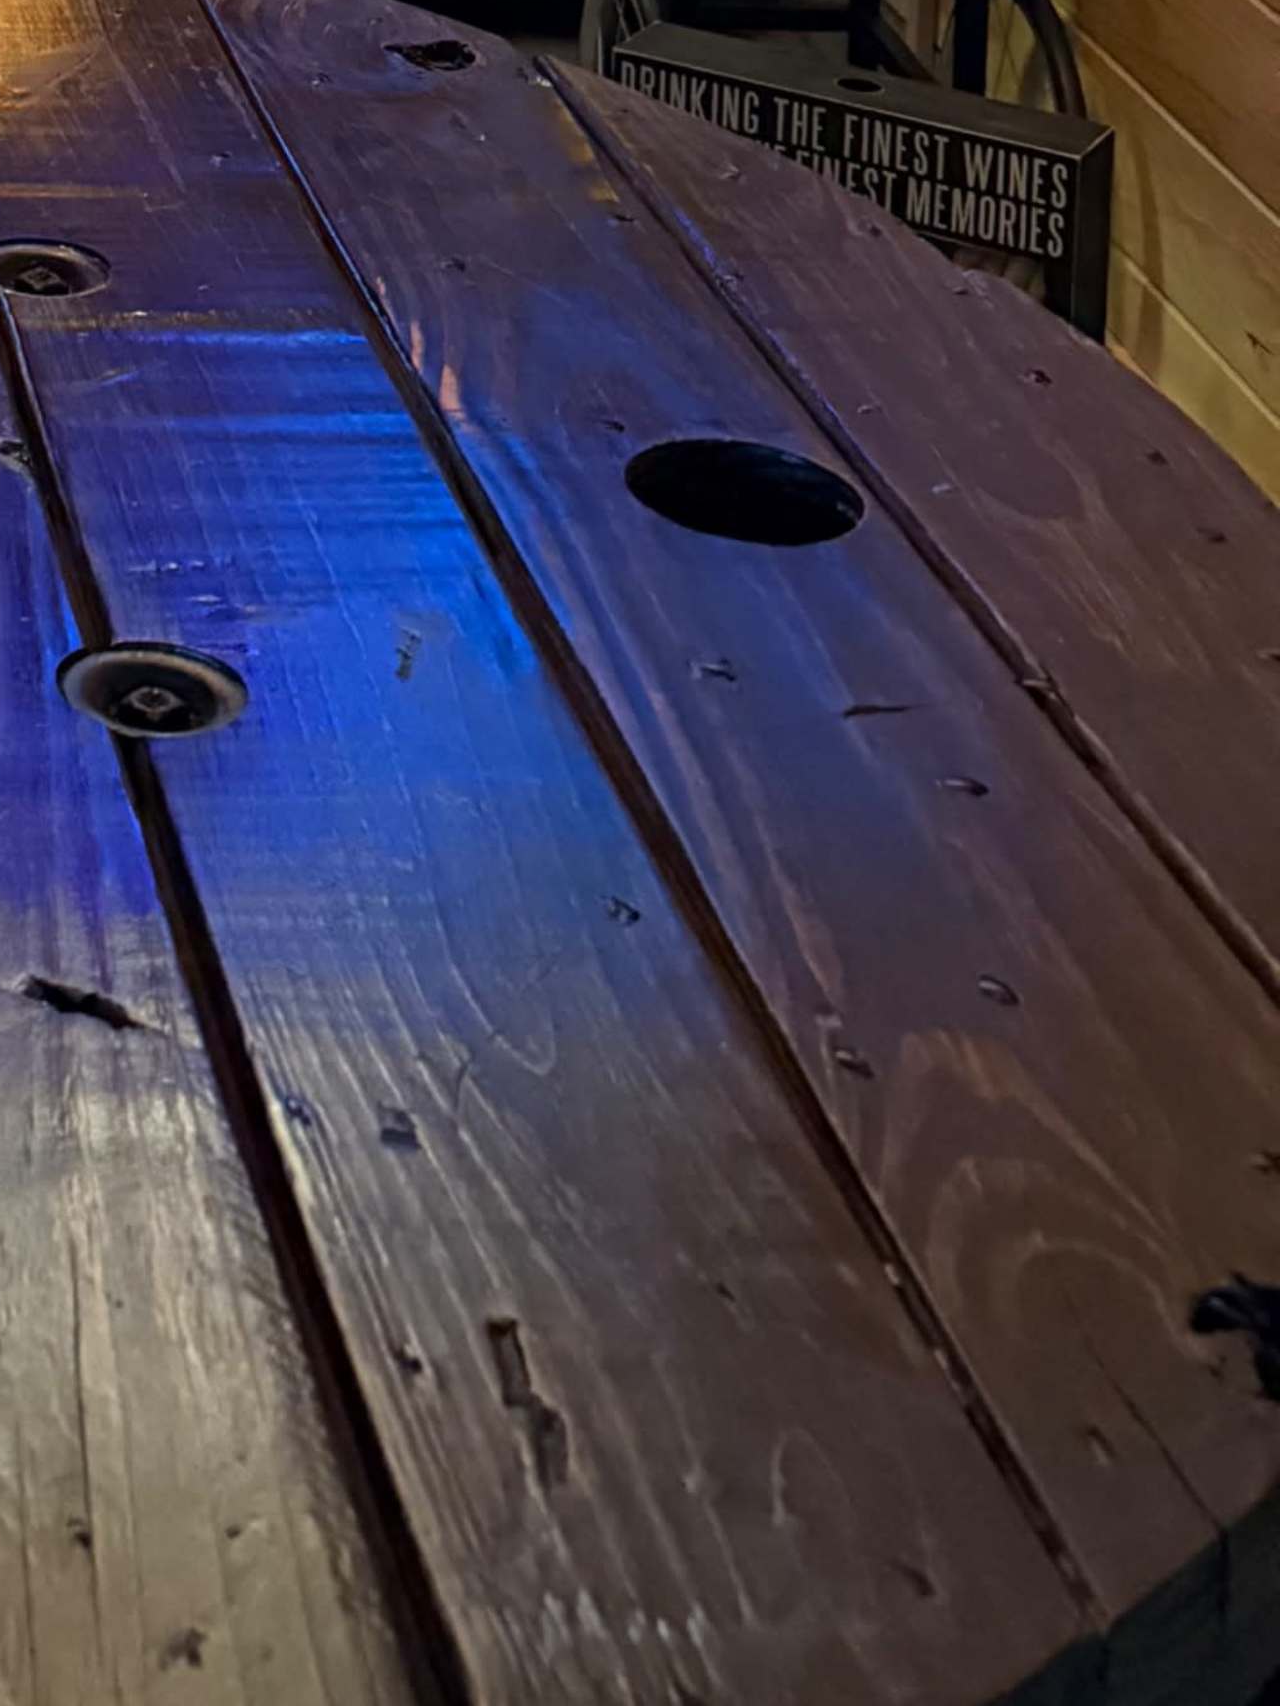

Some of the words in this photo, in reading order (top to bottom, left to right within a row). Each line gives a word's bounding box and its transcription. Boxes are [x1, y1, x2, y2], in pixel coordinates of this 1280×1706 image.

[619, 58, 761, 136] DRINKING
[772, 95, 828, 153] THE
[842, 112, 951, 180] FINEST
[961, 139, 1069, 211] WINES
[905, 174, 1066, 260] MEMORIES
